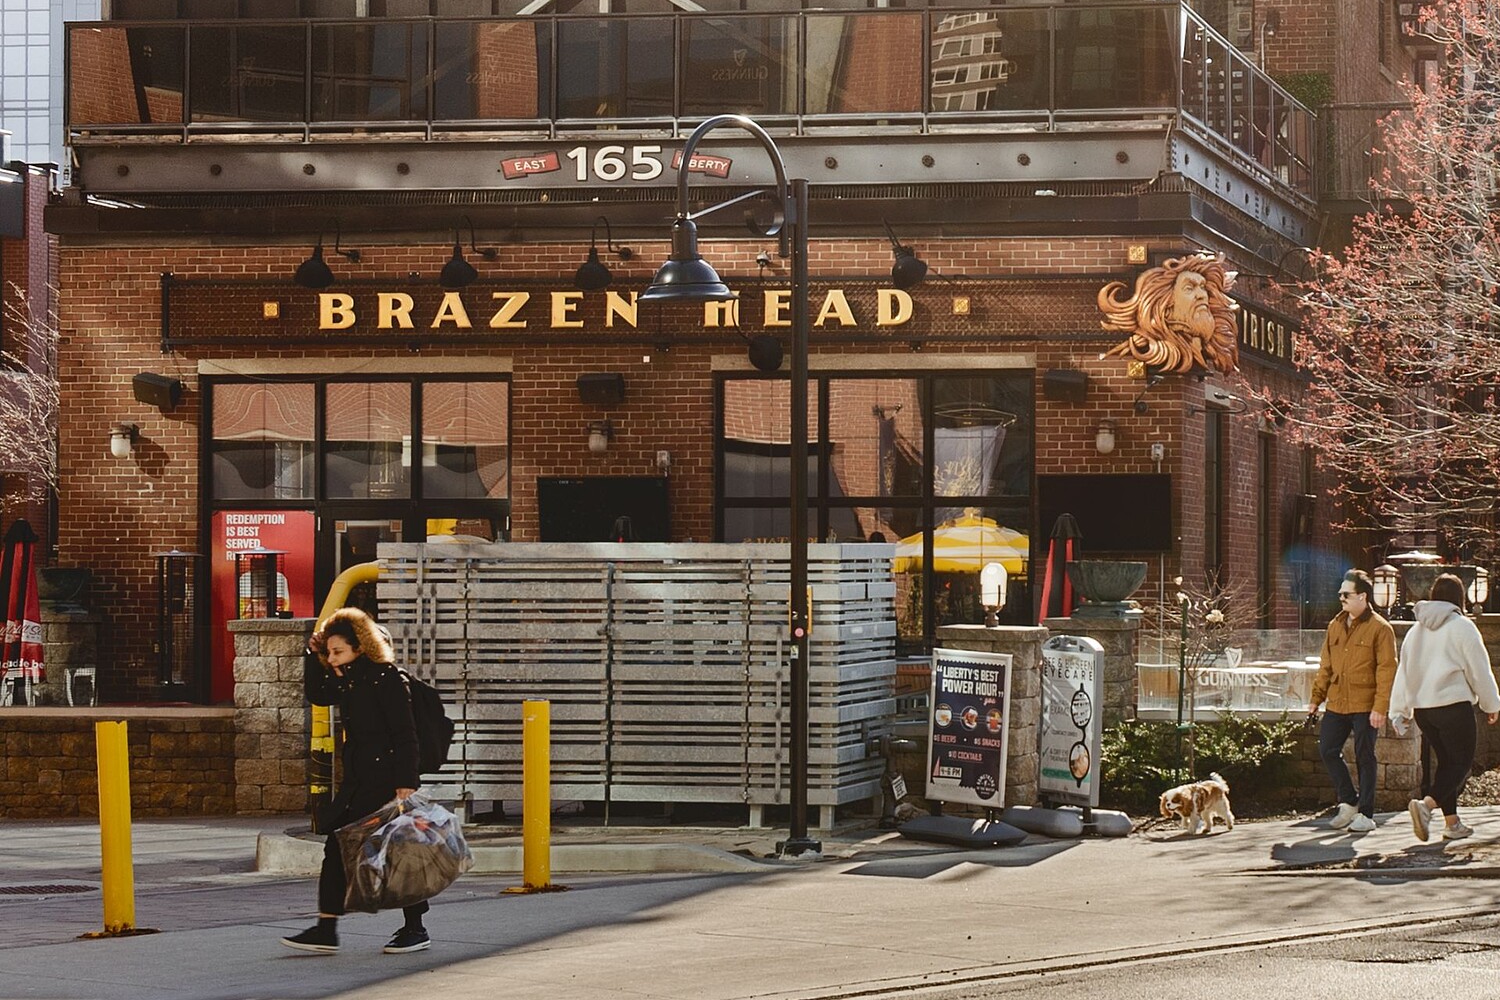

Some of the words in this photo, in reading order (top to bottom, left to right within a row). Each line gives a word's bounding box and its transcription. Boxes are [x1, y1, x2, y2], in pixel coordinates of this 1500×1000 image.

[515, 158, 547, 172] EAST
[566, 145, 663, 182] 165
[677, 157, 728, 172] BERTY
[318, 290, 638, 330] BRAZEN
[703, 289, 914, 328] HEAD
[1243, 309, 1285, 358] IRISH
[226, 513, 285, 525] REDEMPTION
[226, 526, 236, 537] IS
[237, 526, 259, 537] BEST
[225, 538, 261, 549] SERVED
[980, 669, 999, 682] BEST
[1043, 665, 1093, 681] EYECARE
[1197, 670, 1269, 687] GUINNESS
[941, 678, 974, 695] POWER
